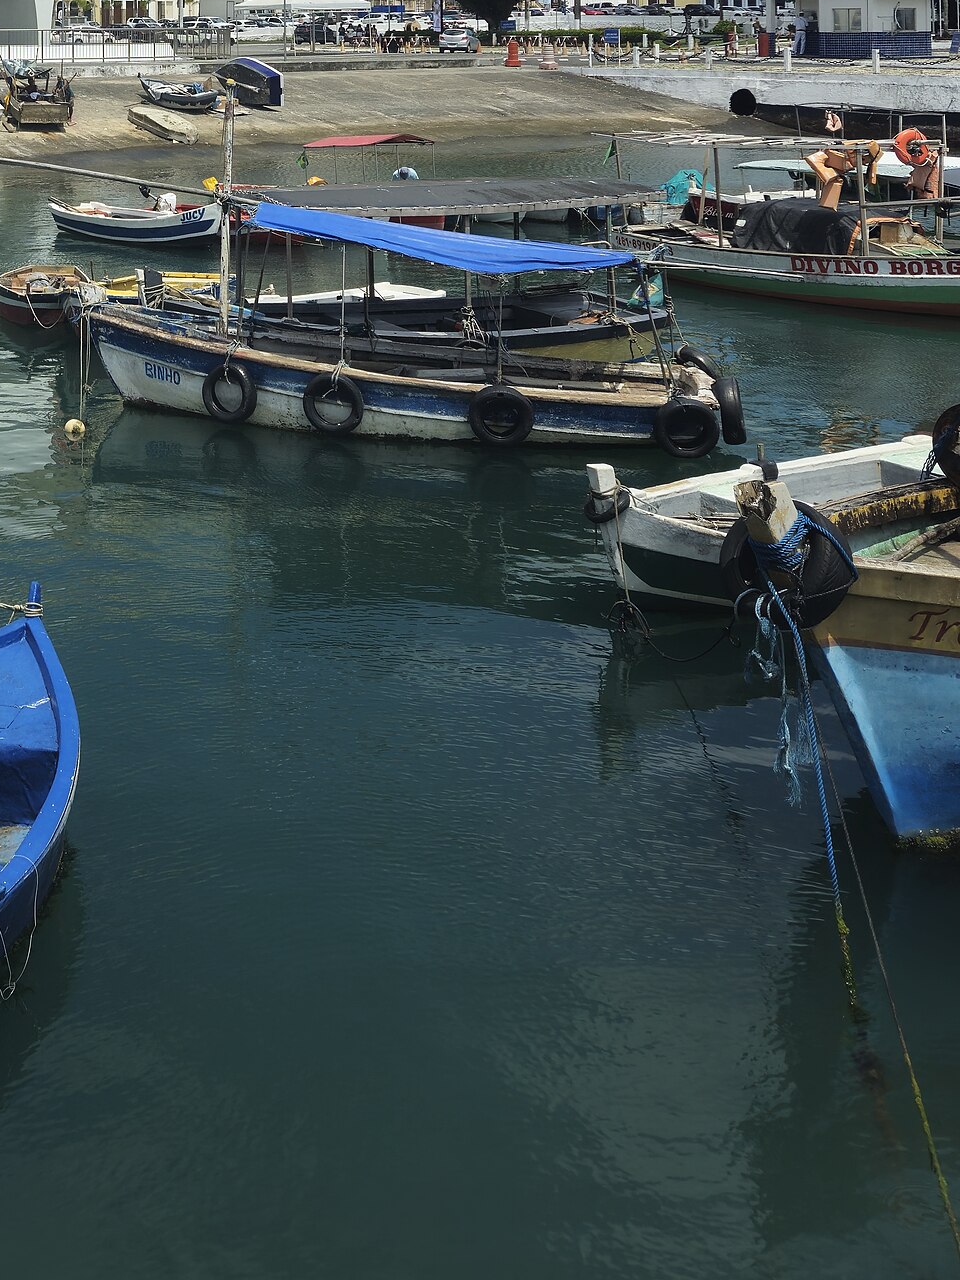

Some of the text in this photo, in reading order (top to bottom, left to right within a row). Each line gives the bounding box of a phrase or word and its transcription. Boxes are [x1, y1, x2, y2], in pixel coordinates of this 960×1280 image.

[790, 256, 960, 277] DIVINO BORG
[144, 361, 181, 386] BINHO
[908, 608, 960, 645] Tr
